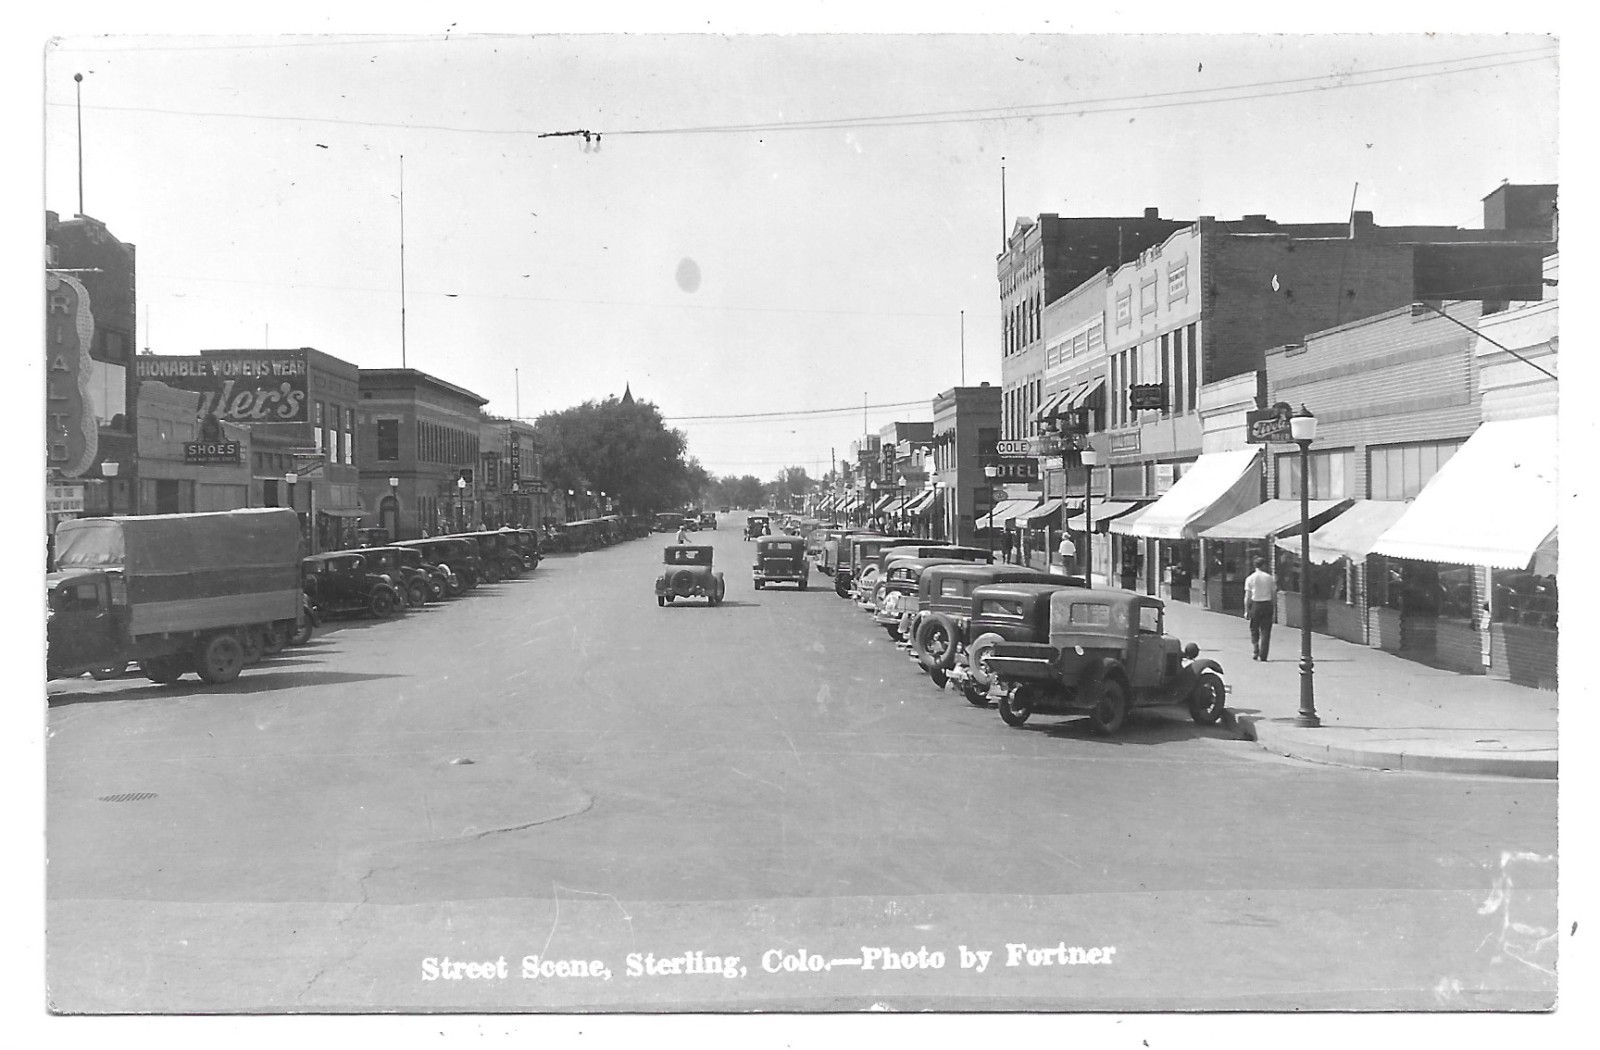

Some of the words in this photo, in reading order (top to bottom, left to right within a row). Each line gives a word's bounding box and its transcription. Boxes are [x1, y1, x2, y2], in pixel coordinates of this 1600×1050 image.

[211, 360, 270, 376] WOMENS
[271, 360, 306, 376] WEAR
[50, 295, 71, 462] RIALTO
[188, 444, 236, 455] SHOES
[998, 442, 1028, 453] COLE
[996, 464, 1037, 478] OTEL
